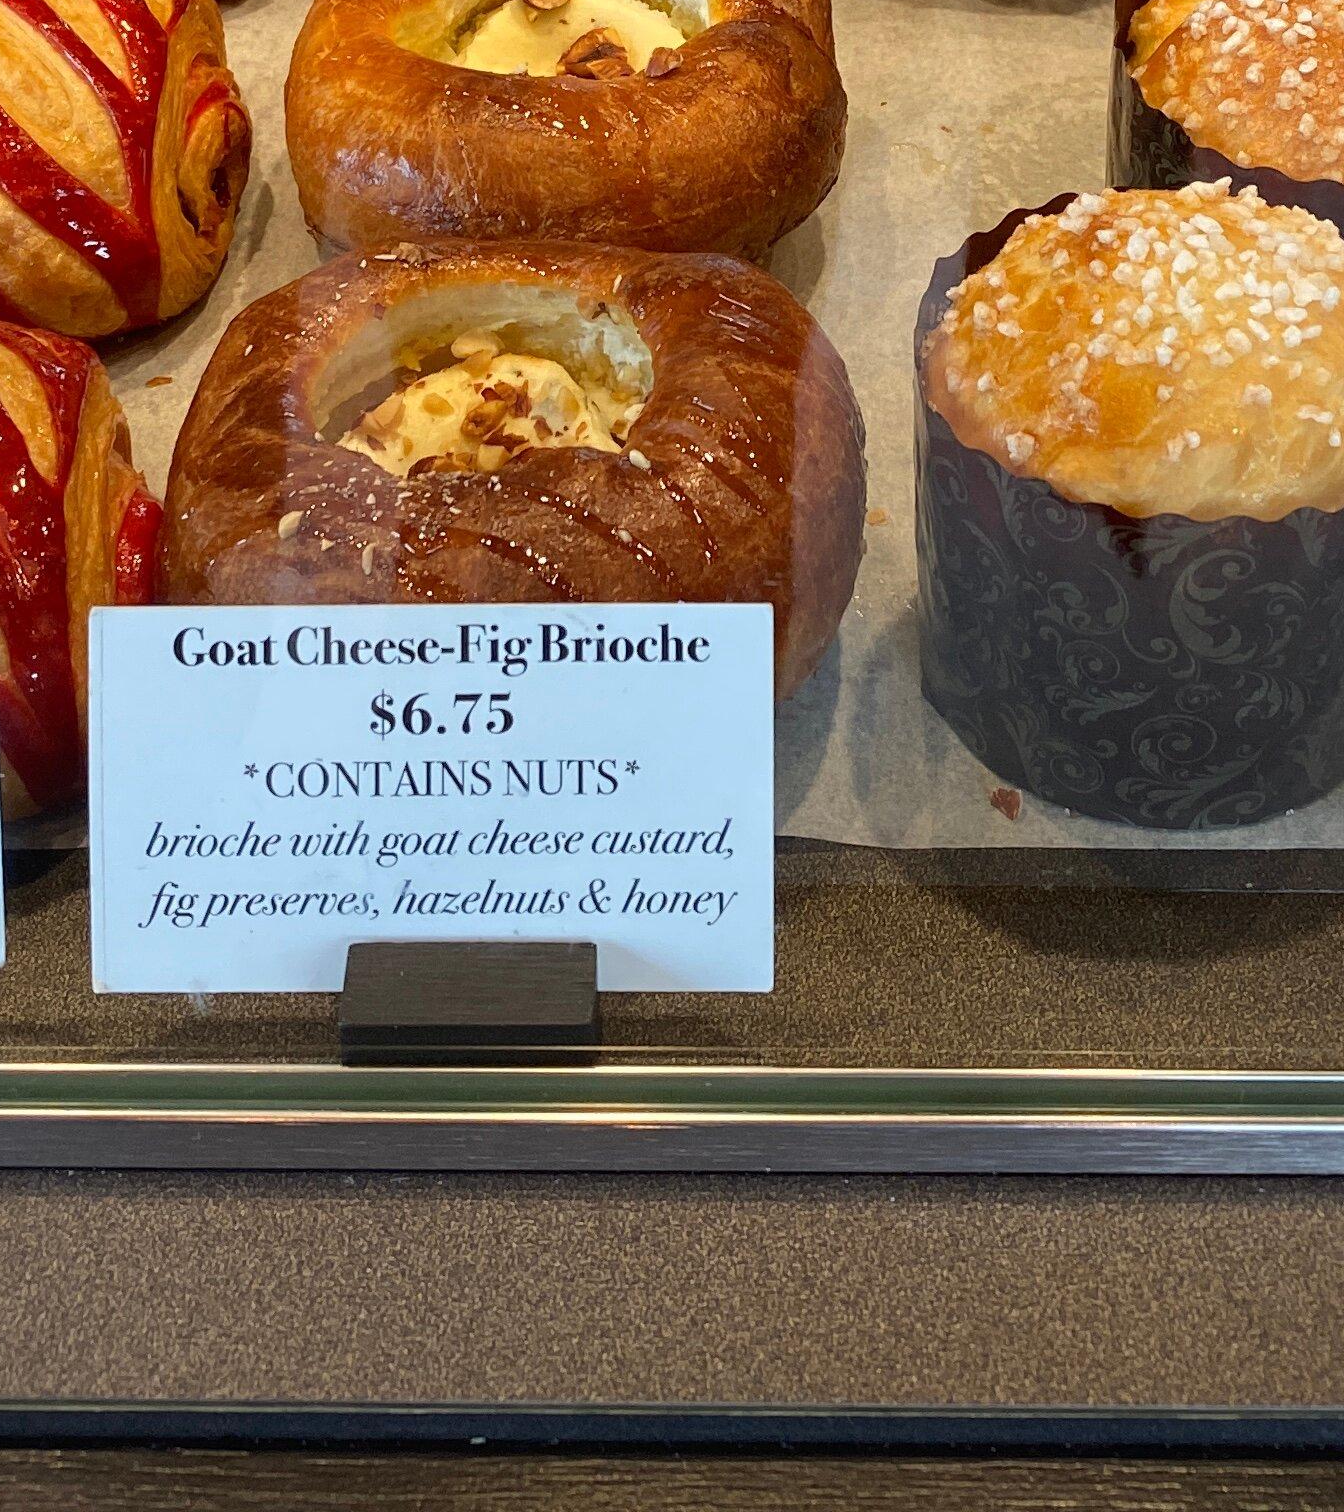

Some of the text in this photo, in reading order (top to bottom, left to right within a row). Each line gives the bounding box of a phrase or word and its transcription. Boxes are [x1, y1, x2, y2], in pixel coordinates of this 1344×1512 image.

[173, 623, 711, 676] Goat Cheese-Fig Brioche
[370, 688, 514, 740] $6.75
[145, 817, 734, 866] brioche with goat cheese custard,
[137, 878, 737, 928] fig preserves, hazelnuts & honey
